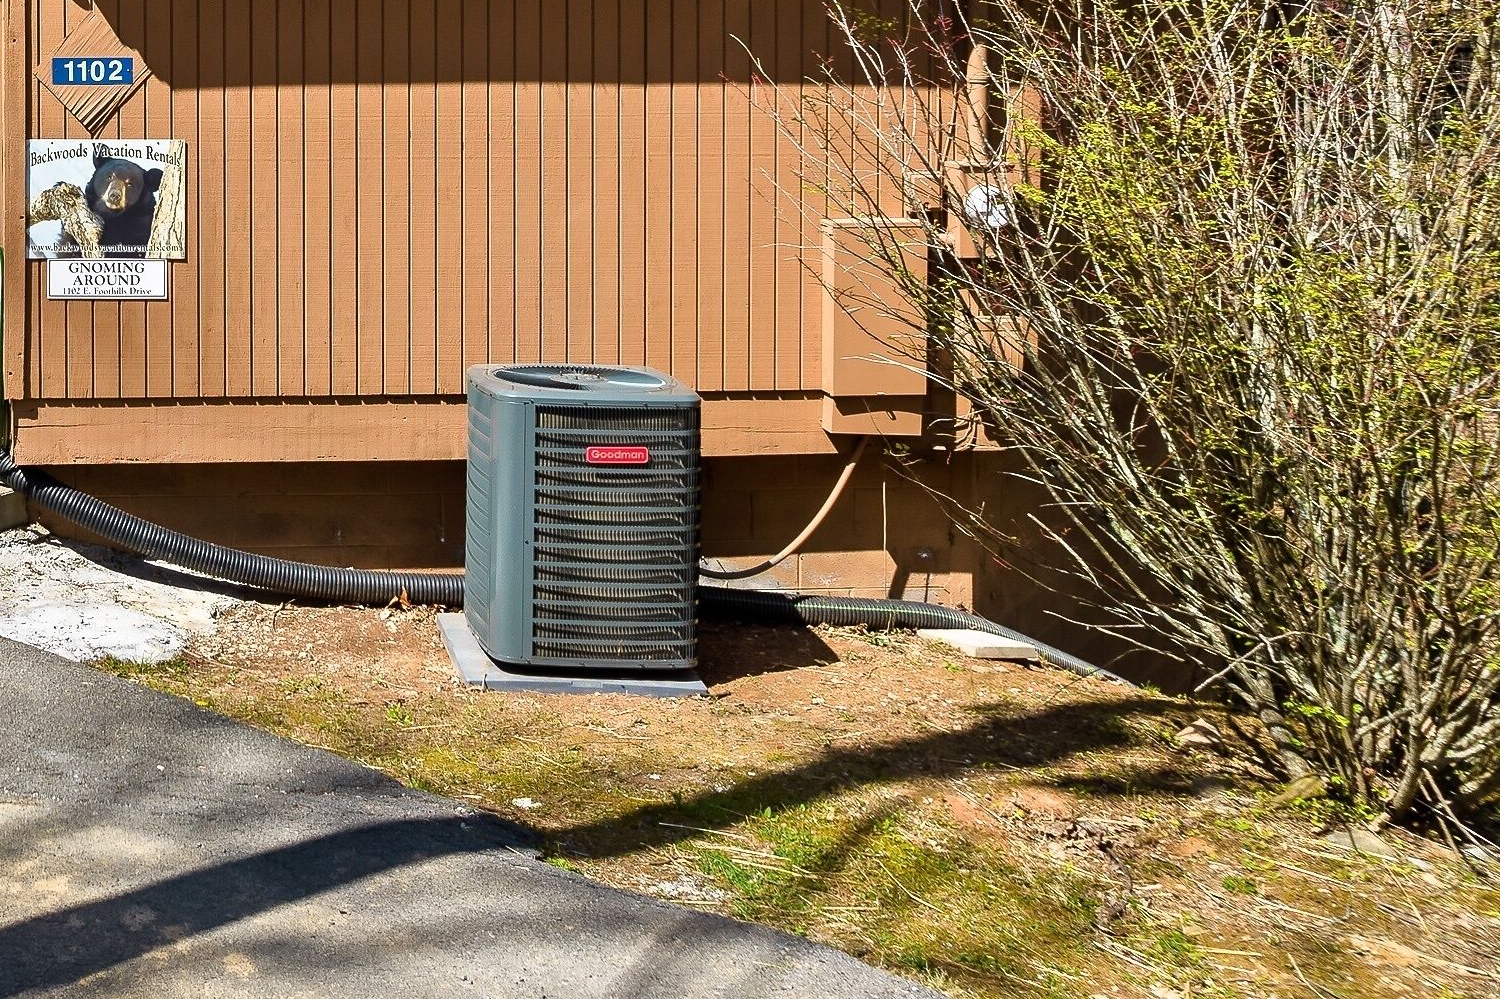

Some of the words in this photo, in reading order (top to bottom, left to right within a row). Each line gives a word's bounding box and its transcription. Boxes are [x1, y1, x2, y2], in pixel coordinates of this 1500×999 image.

[63, 59, 123, 82] 1102
[30, 143, 88, 167] Backwoods
[92, 143, 143, 158] Vacation
[146, 145, 180, 167] Rentals
[68, 262, 145, 274] GNOMING
[73, 275, 141, 286] AROUND
[62, 287, 81, 295] 1102
[83, 287, 91, 295] E.
[94, 287, 128, 295] Foothills
[129, 287, 152, 295] Drive
[591, 450, 645, 459] Goodman
